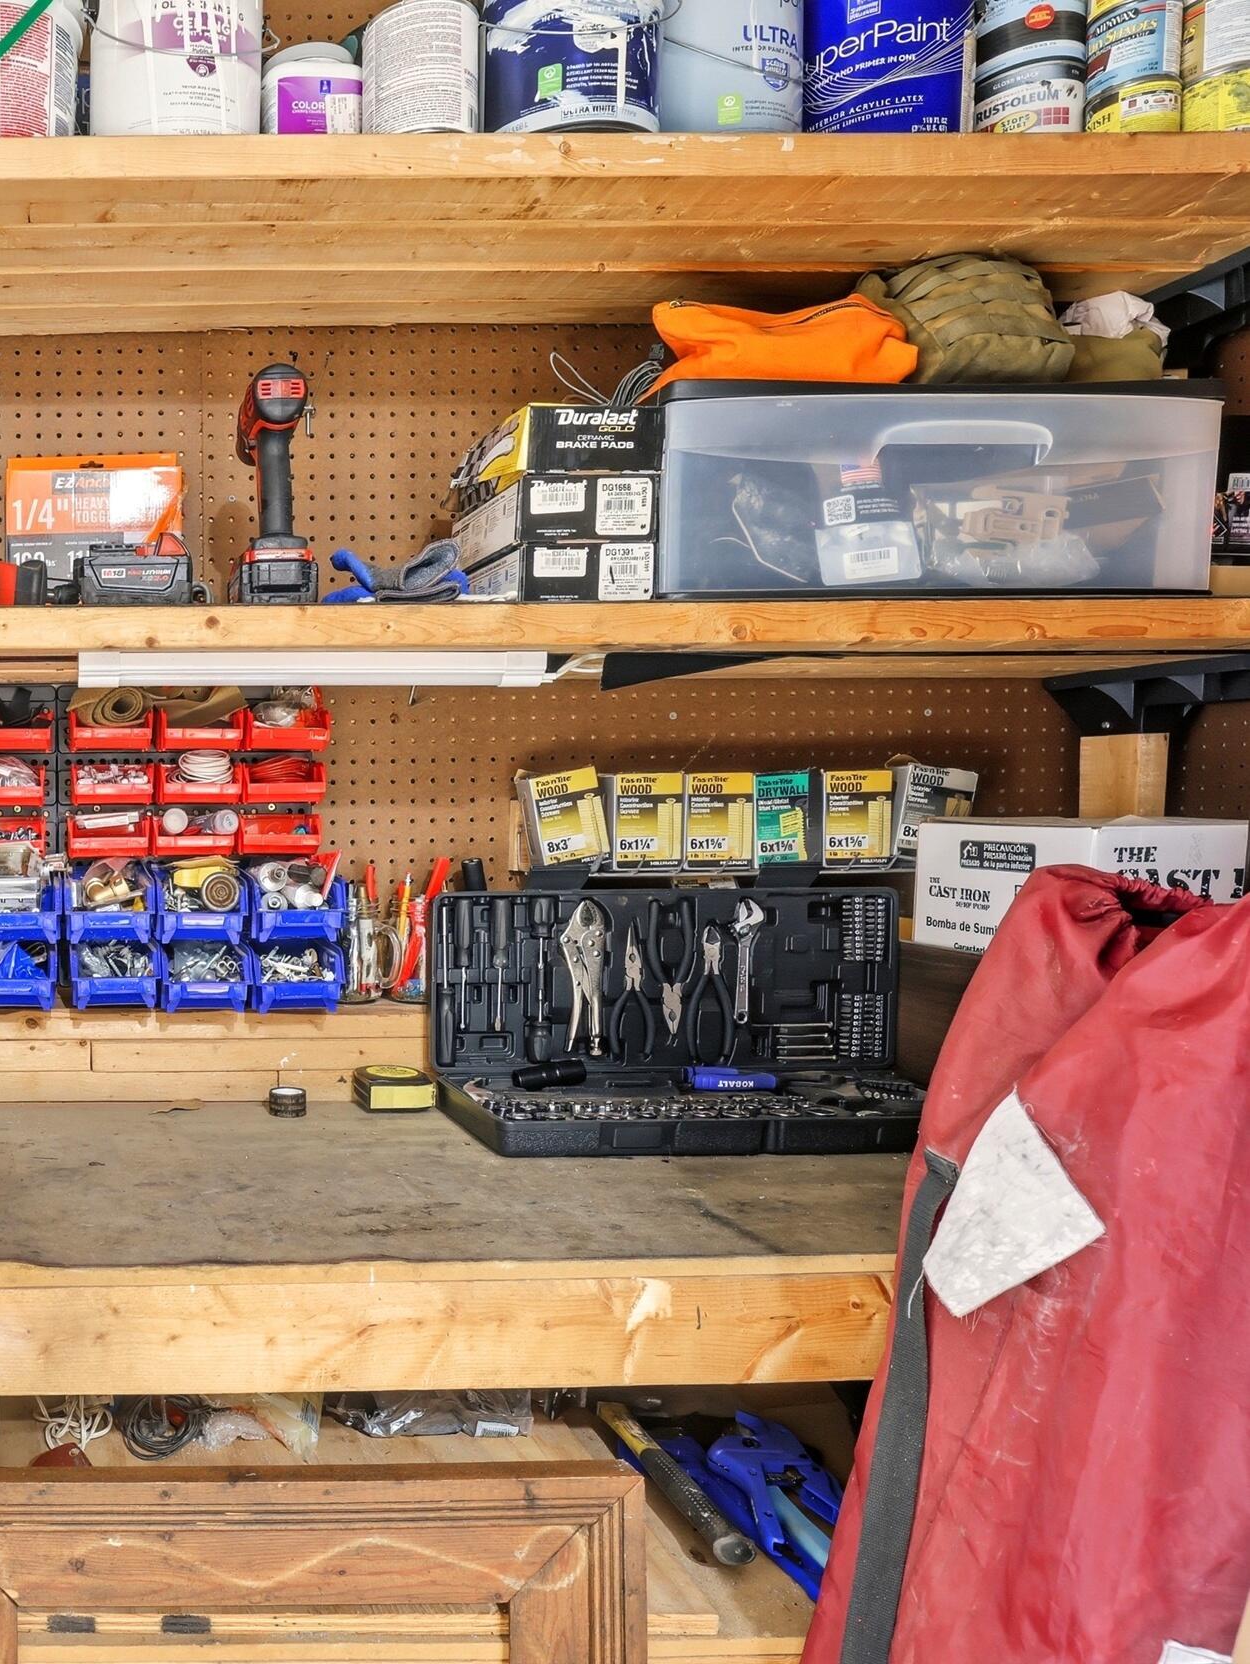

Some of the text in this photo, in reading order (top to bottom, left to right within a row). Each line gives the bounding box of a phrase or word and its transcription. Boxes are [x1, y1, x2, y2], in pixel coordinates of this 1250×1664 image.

[743, 24, 798, 52] ULTRA
[854, 57, 886, 72] PRIMER
[592, 103, 617, 113] WHITE
[849, 97, 892, 115] ACRYLIC
[895, 95, 924, 104] LATEX
[976, 89, 1061, 125] RUST-OLEUM
[554, 408, 638, 426] Duralast
[556, 441, 635, 449] BRAKE PADS
[54, 477, 75, 489] EZ
[12, 498, 69, 531] 1/4"
[912, 772, 944, 786] WOOD
[537, 783, 568, 798] WOOD
[620, 784, 652, 795] WOOD
[691, 783, 723, 794] WOOD
[758, 784, 808, 798] DRYWALL
[829, 782, 863, 792] WOOD
[903, 825, 918, 837] 8x
[1114, 846, 1158, 862] THE
[1117, 868, 1221, 899] AST
[929, 885, 991, 903] CAST IRON
[926, 916, 998, 936] Bomba de Sumi
[953, 942, 985, 953] Caracter
[717, 1080, 754, 1088] KOBALT
